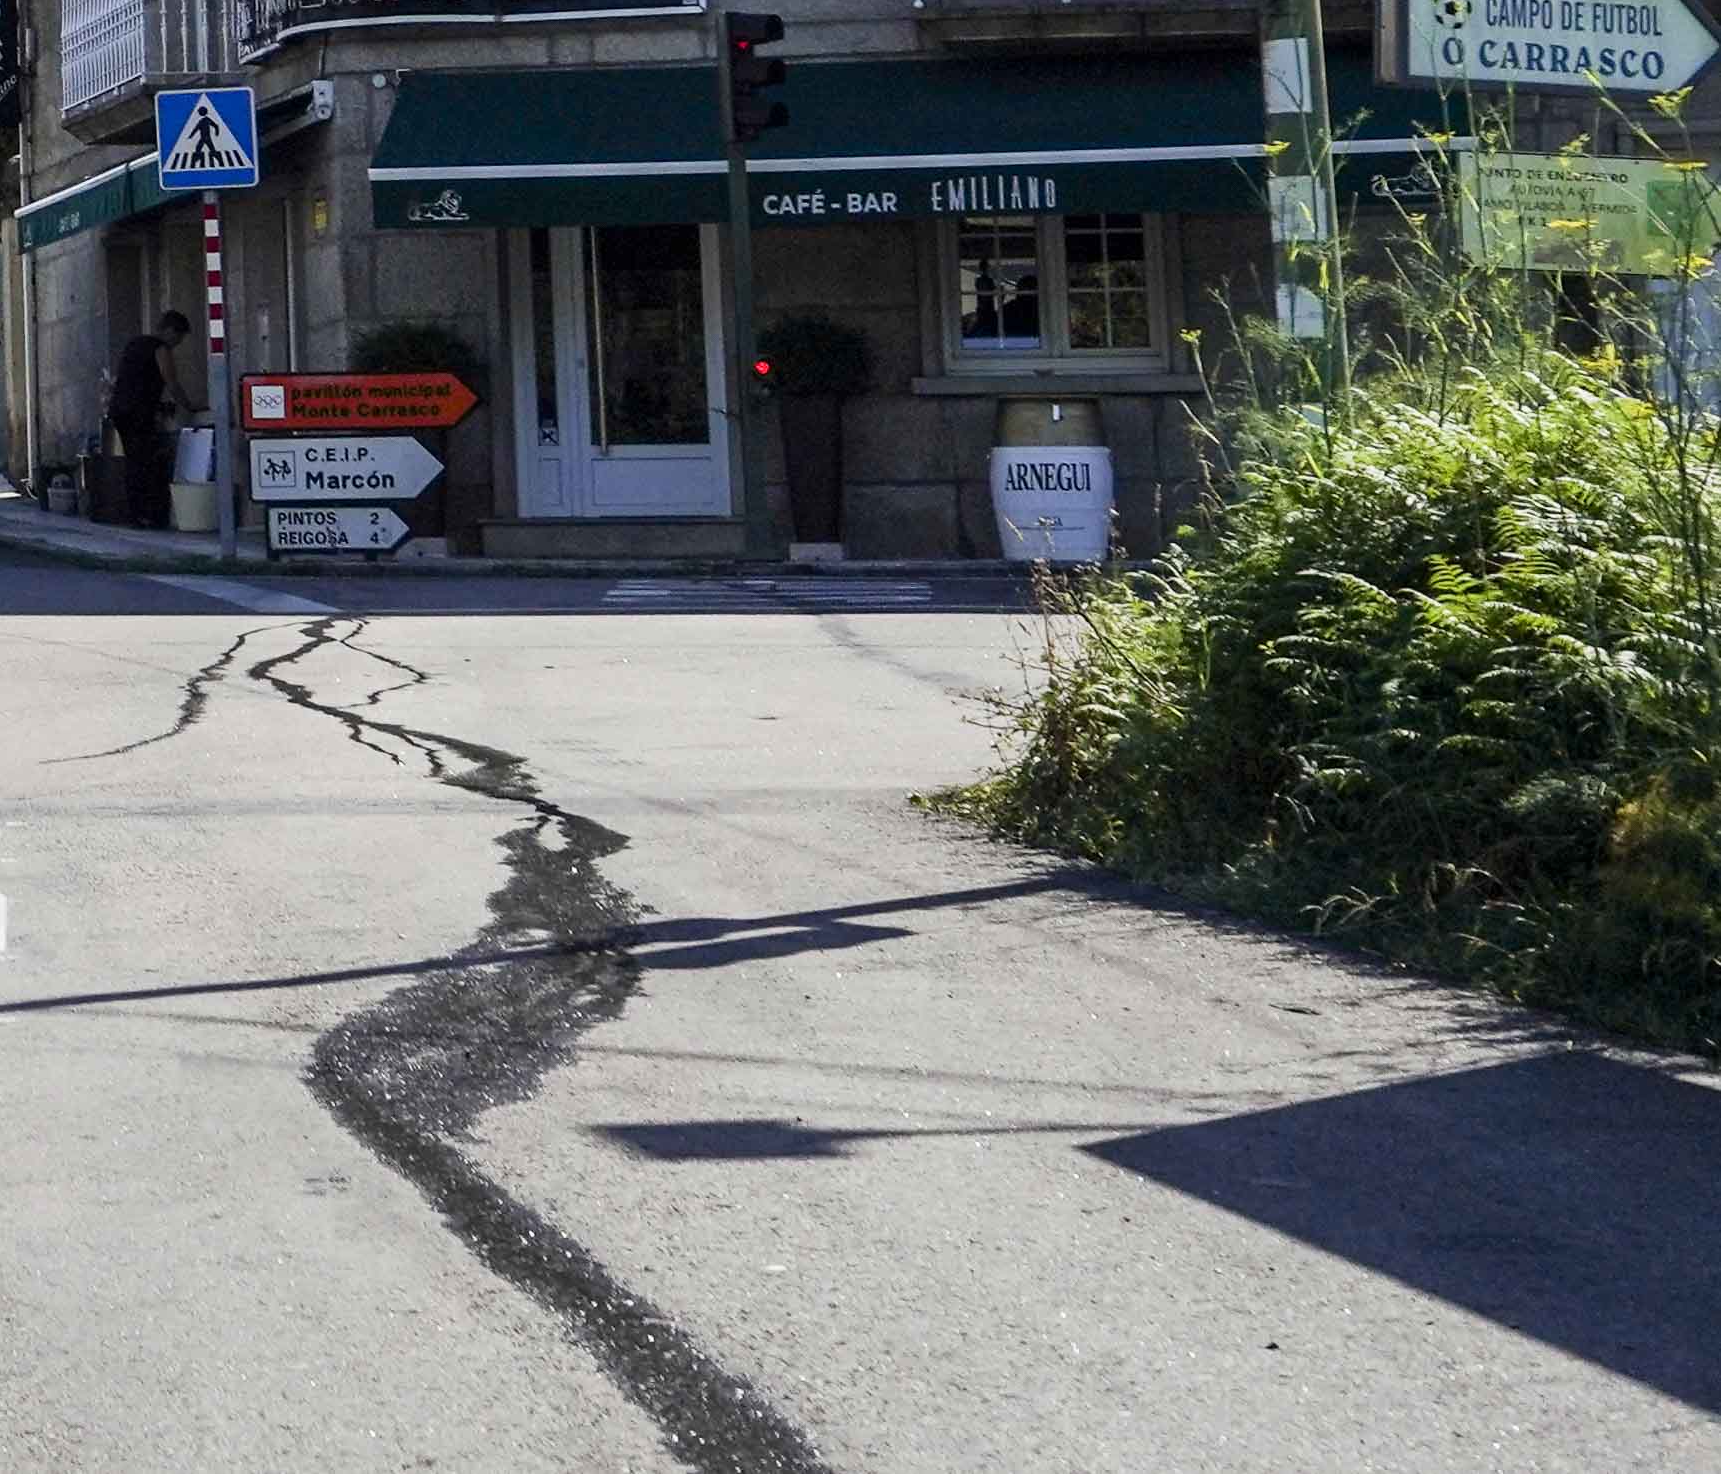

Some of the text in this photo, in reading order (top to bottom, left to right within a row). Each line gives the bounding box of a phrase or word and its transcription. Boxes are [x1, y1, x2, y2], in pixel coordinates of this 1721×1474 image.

[1561, 3, 1584, 31] DE
[1592, 3, 1663, 36] FUTBOL
[1443, 38, 1665, 79] O CARRASCO
[763, 188, 826, 214] CAFÉ
[847, 192, 897, 213] BAR
[931, 175, 1057, 212] EMILIANO
[368, 382, 451, 398] municipal
[292, 404, 440, 418] Monte Carrasco
[305, 447, 376, 463] C.E.I.P.
[305, 470, 395, 489] Marcón
[1004, 462, 1091, 492] ARNEGUI
[277, 511, 380, 525] PINTOS 2
[278, 531, 379, 545] REIGOSA 4
